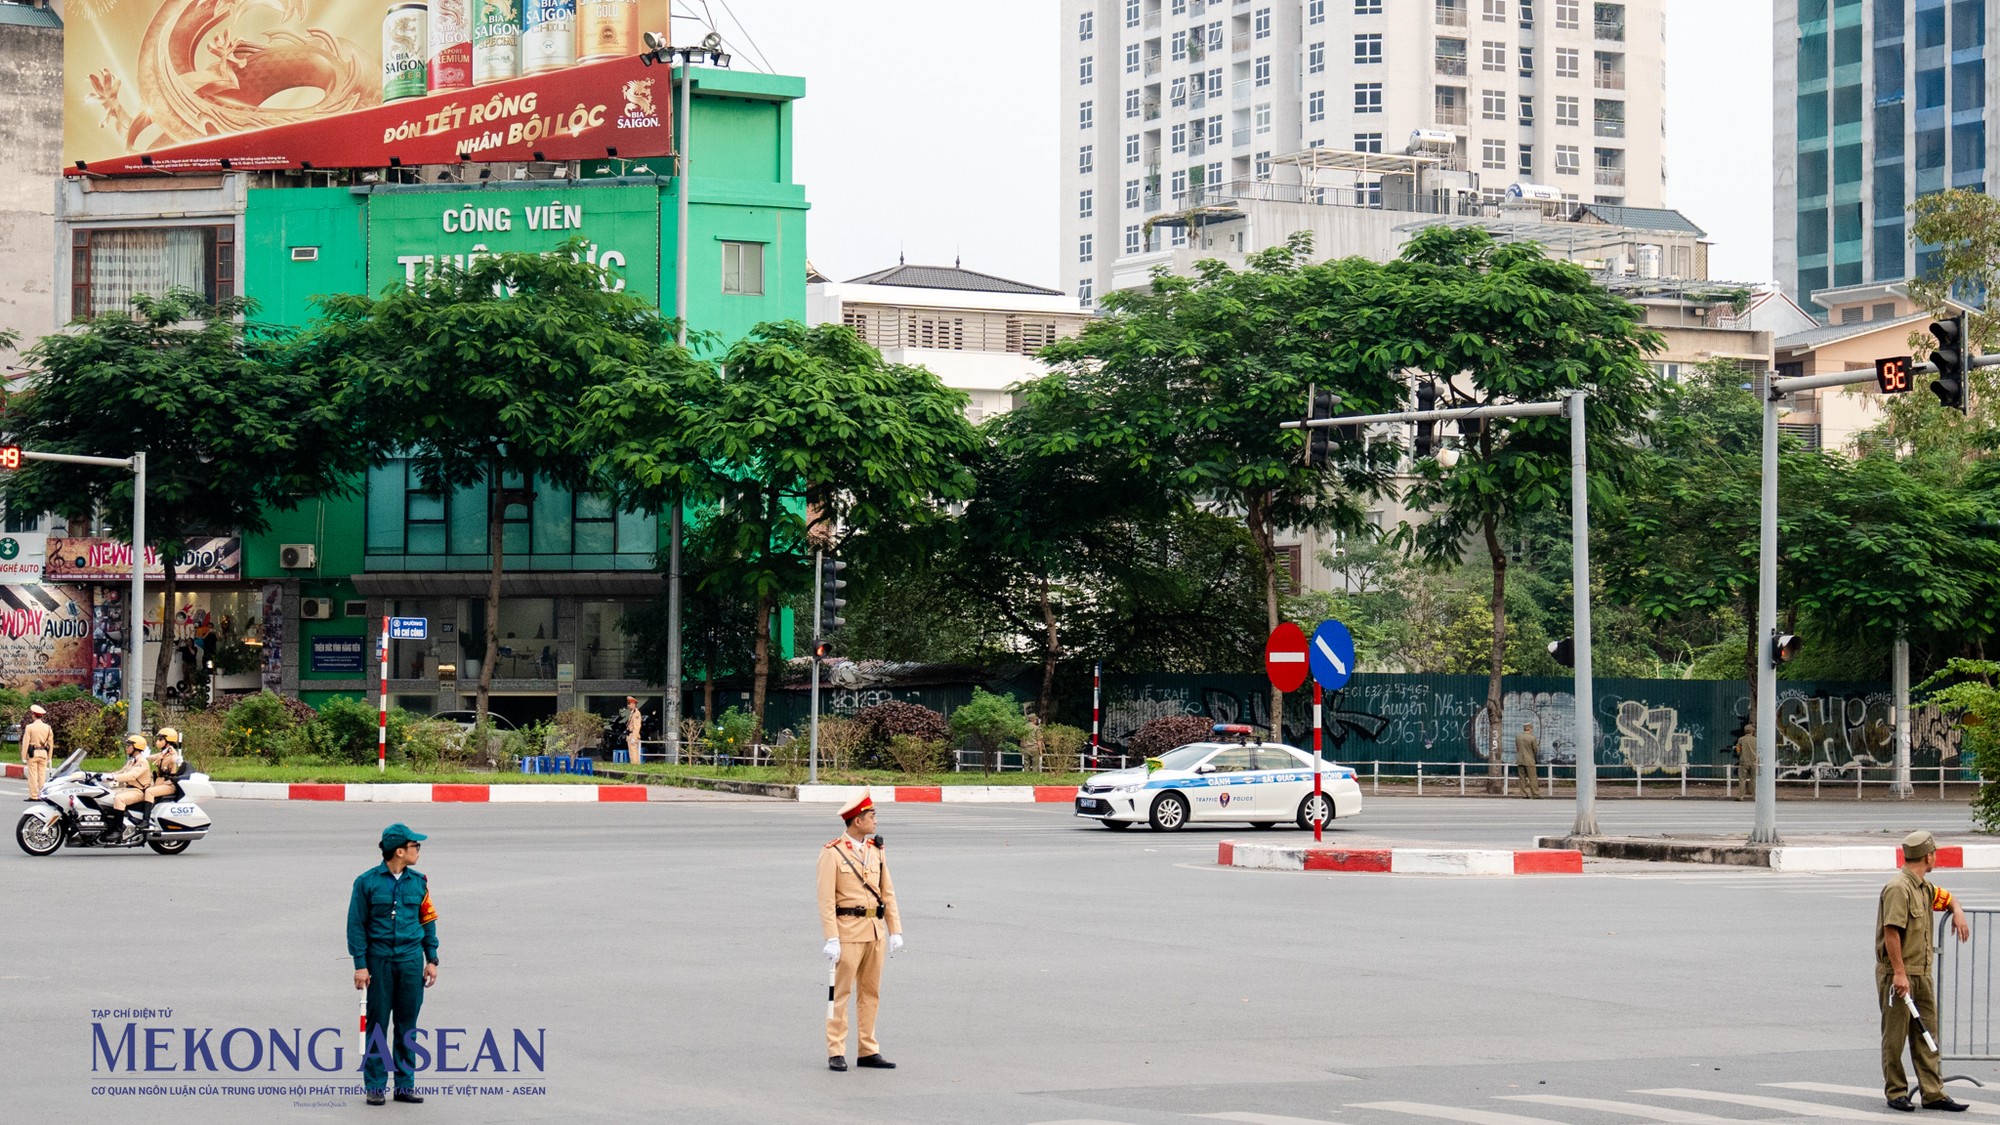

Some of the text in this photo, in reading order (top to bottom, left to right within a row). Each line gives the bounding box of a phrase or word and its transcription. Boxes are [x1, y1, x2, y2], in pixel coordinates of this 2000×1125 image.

[526, 8, 575, 24] SAIGON
[597, 5, 618, 17] GOLD
[488, 15, 504, 23] BIA
[475, 23, 519, 39] SAIGON
[395, 52, 409, 60] BIA
[386, 60, 425, 74] SAIGON
[383, 91, 538, 144] ĐÓN TẾT RỒNG
[631, 111, 645, 119] BIA
[455, 103, 608, 156] NHÂN BỘI LỘC
[617, 117, 660, 129] SAIGON
[442, 200, 582, 233] CÔNG VIÊN
[89, 542, 156, 568] NEWAY
[19, 564, 39, 573] AUTO
[0, 608, 43, 638] WDAY
[1208, 771, 1343, 786] CẢNH SÁT GIAO HÔNG
[170, 806, 194, 814] CSGT
